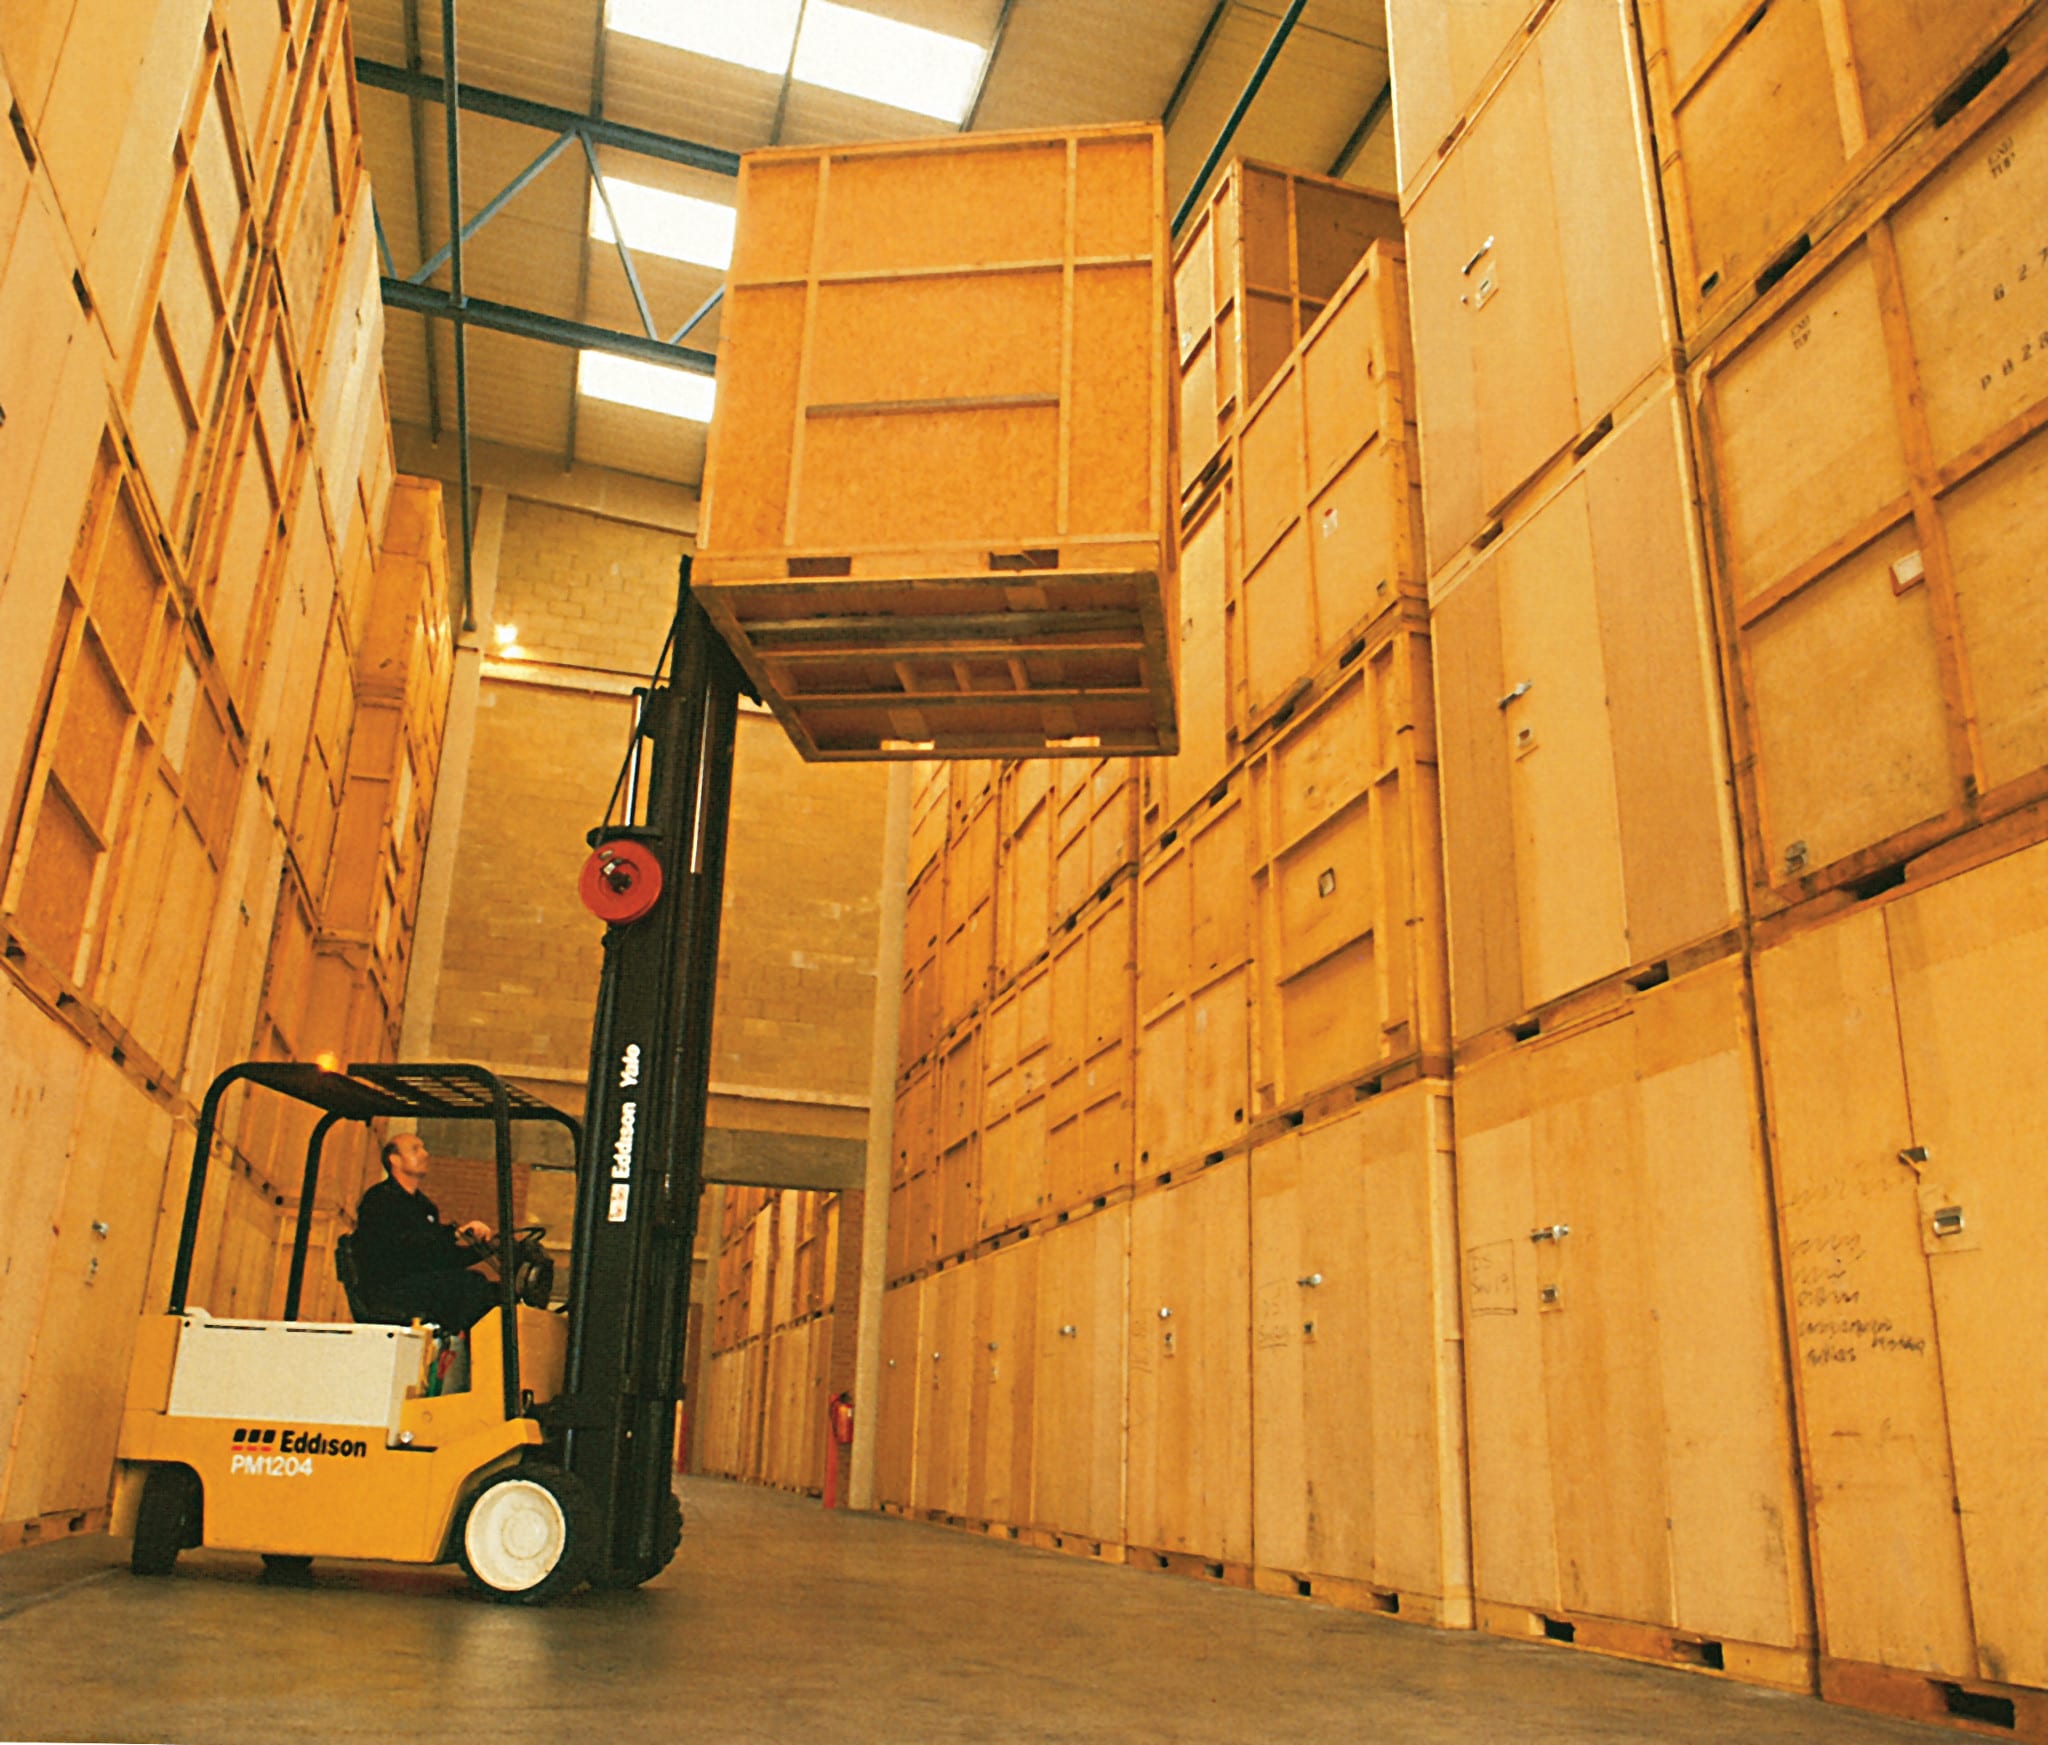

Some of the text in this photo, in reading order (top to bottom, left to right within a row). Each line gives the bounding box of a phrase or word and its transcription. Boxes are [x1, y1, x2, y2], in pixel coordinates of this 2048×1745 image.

[611, 1043, 641, 1179] Eddison Yale
[280, 1430, 367, 1458] Eddison
[231, 1454, 314, 1477] PM1204
